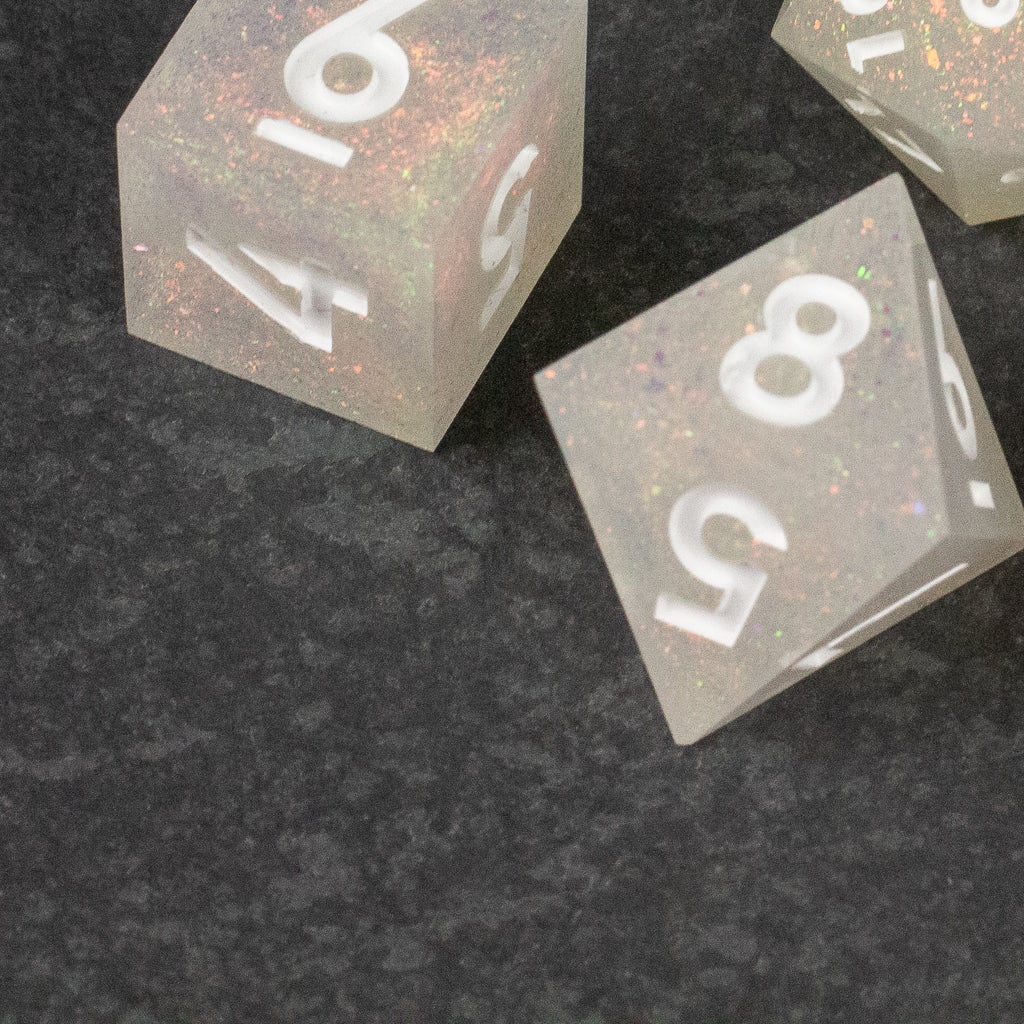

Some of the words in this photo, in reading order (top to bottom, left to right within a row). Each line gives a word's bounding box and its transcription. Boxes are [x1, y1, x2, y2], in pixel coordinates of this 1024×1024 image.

[186, 227, 369, 352] 4
[719, 274, 872, 427] 8
[654, 486, 788, 648] 5
